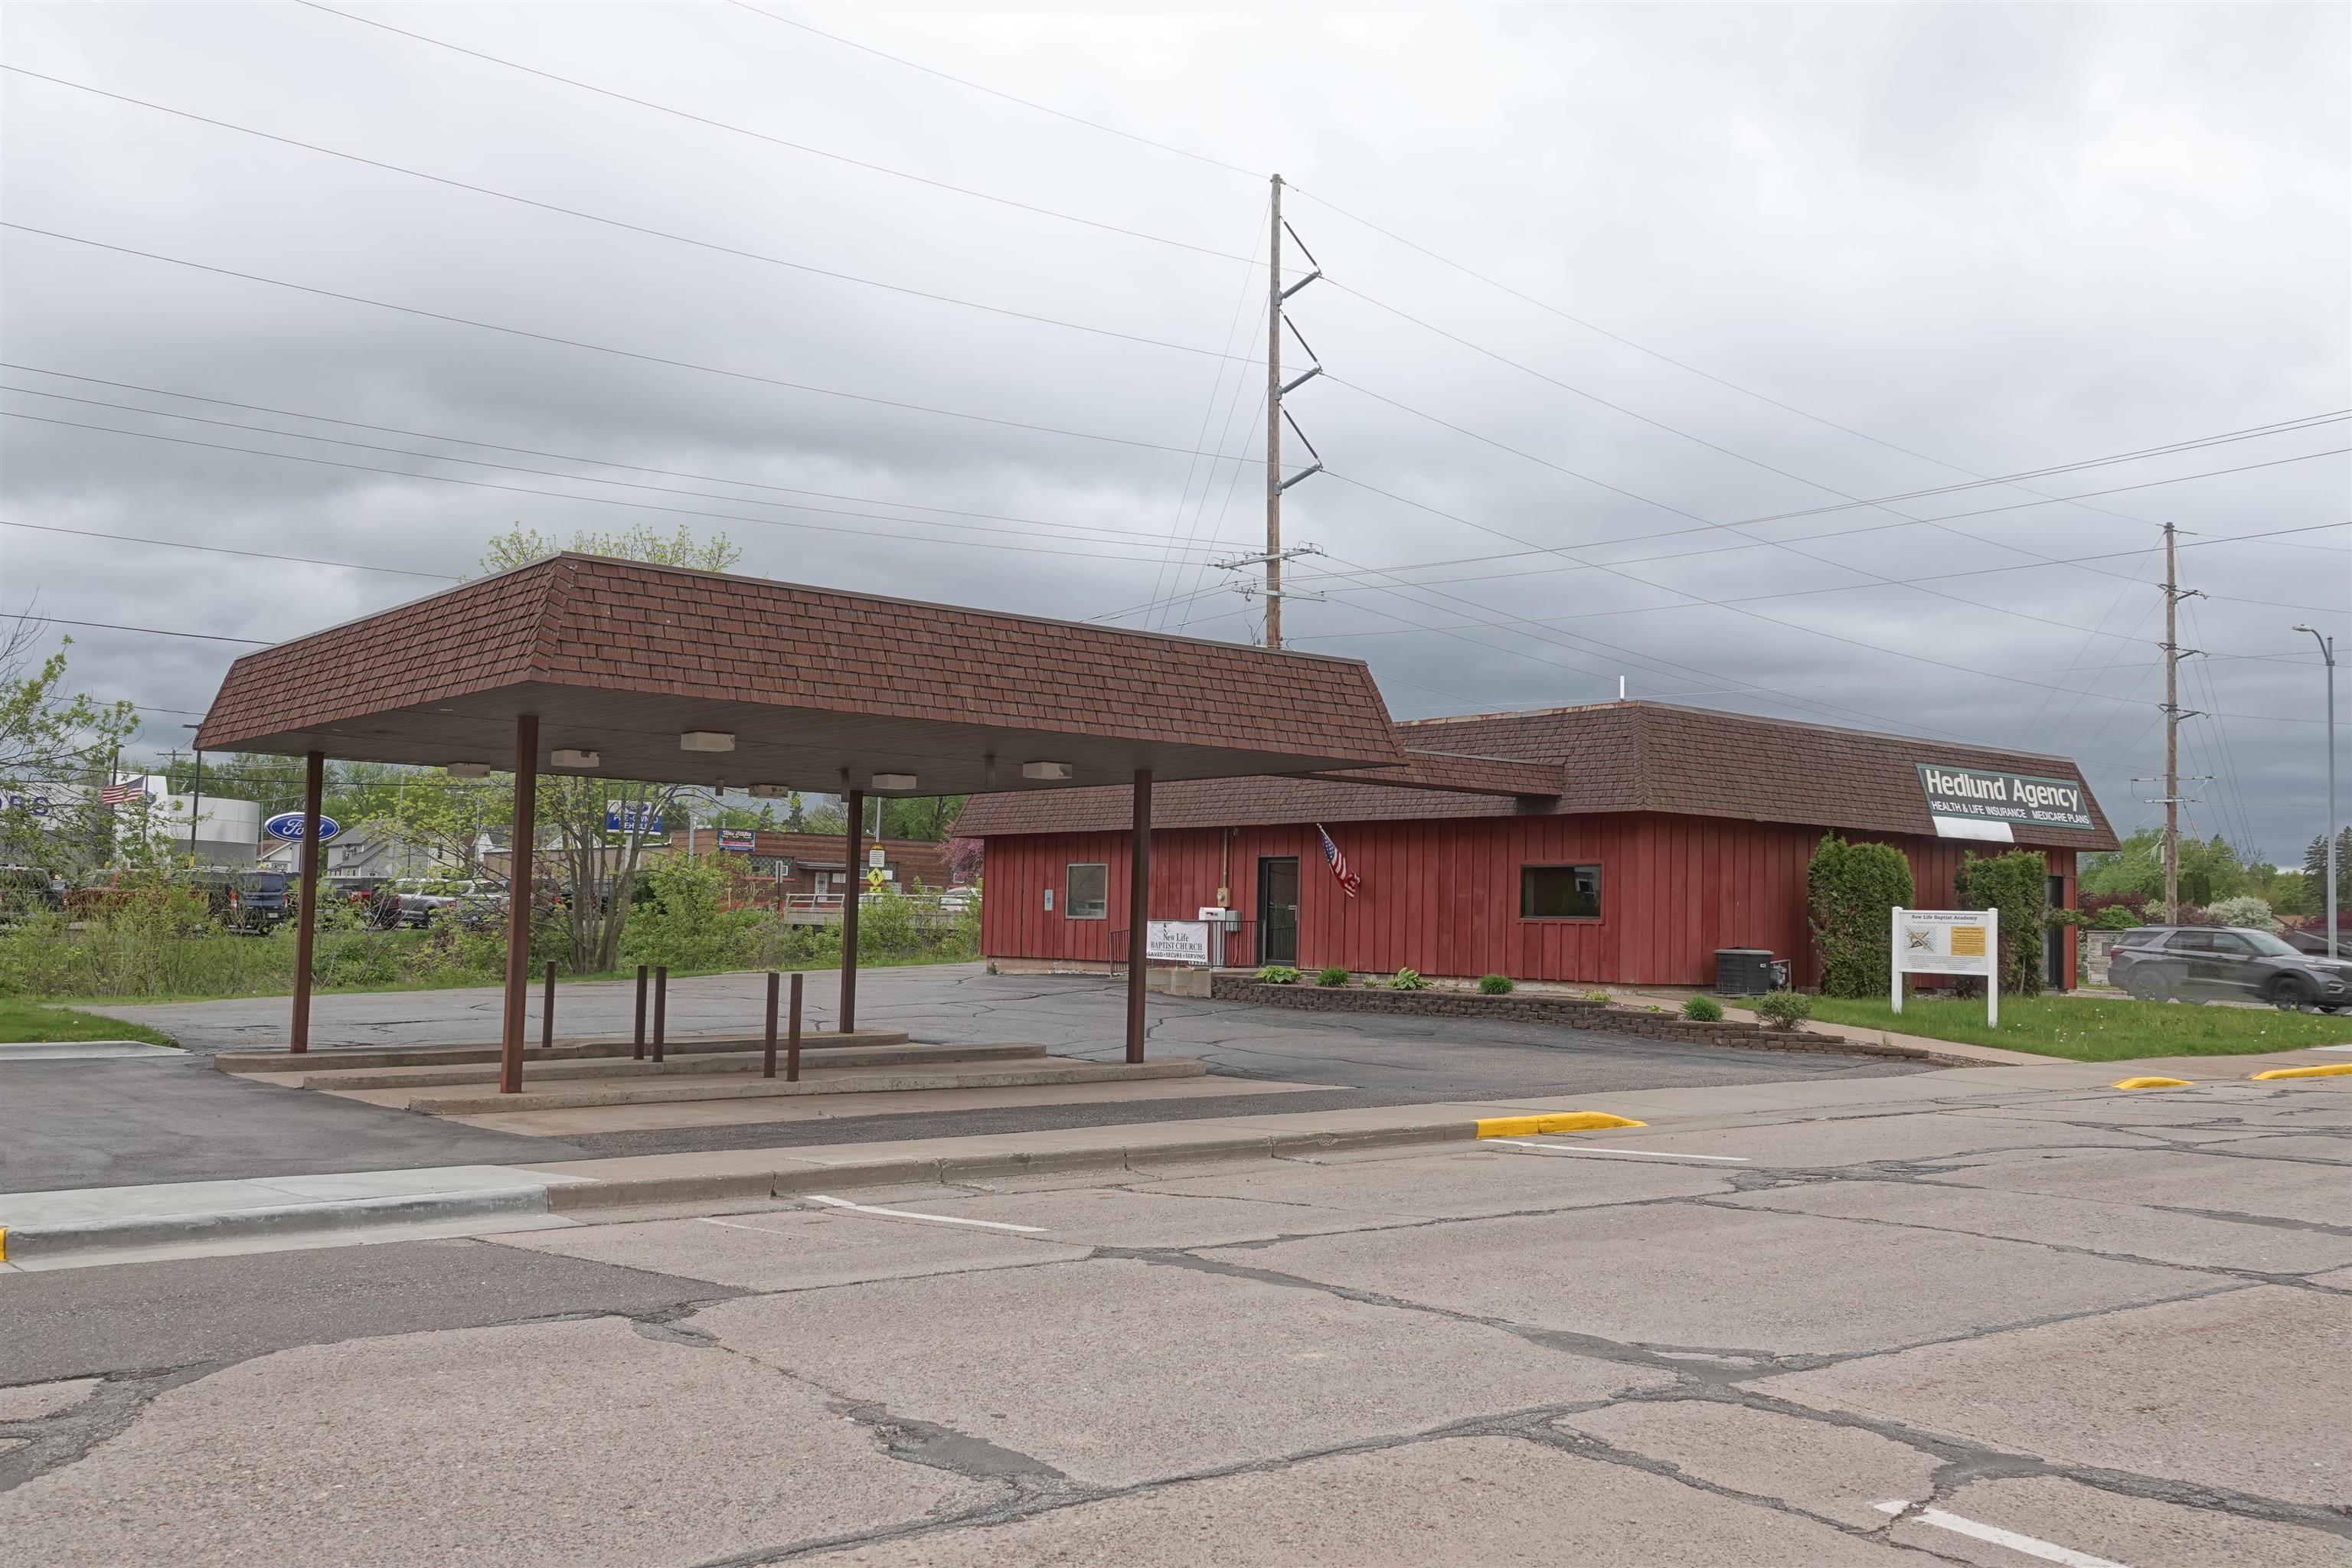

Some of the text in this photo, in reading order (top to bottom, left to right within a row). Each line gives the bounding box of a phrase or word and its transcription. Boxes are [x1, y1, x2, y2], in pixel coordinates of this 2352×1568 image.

[1926, 769, 2078, 812] Hedlund Agency
[1931, 800, 2090, 825] HEALTH & LIFE INSURANCE MEDICARE PLANS
[283, 818, 325, 835] Fo
[1151, 941, 1203, 951] BAPTIST CHURCH
[1176, 933, 1189, 942] Life
